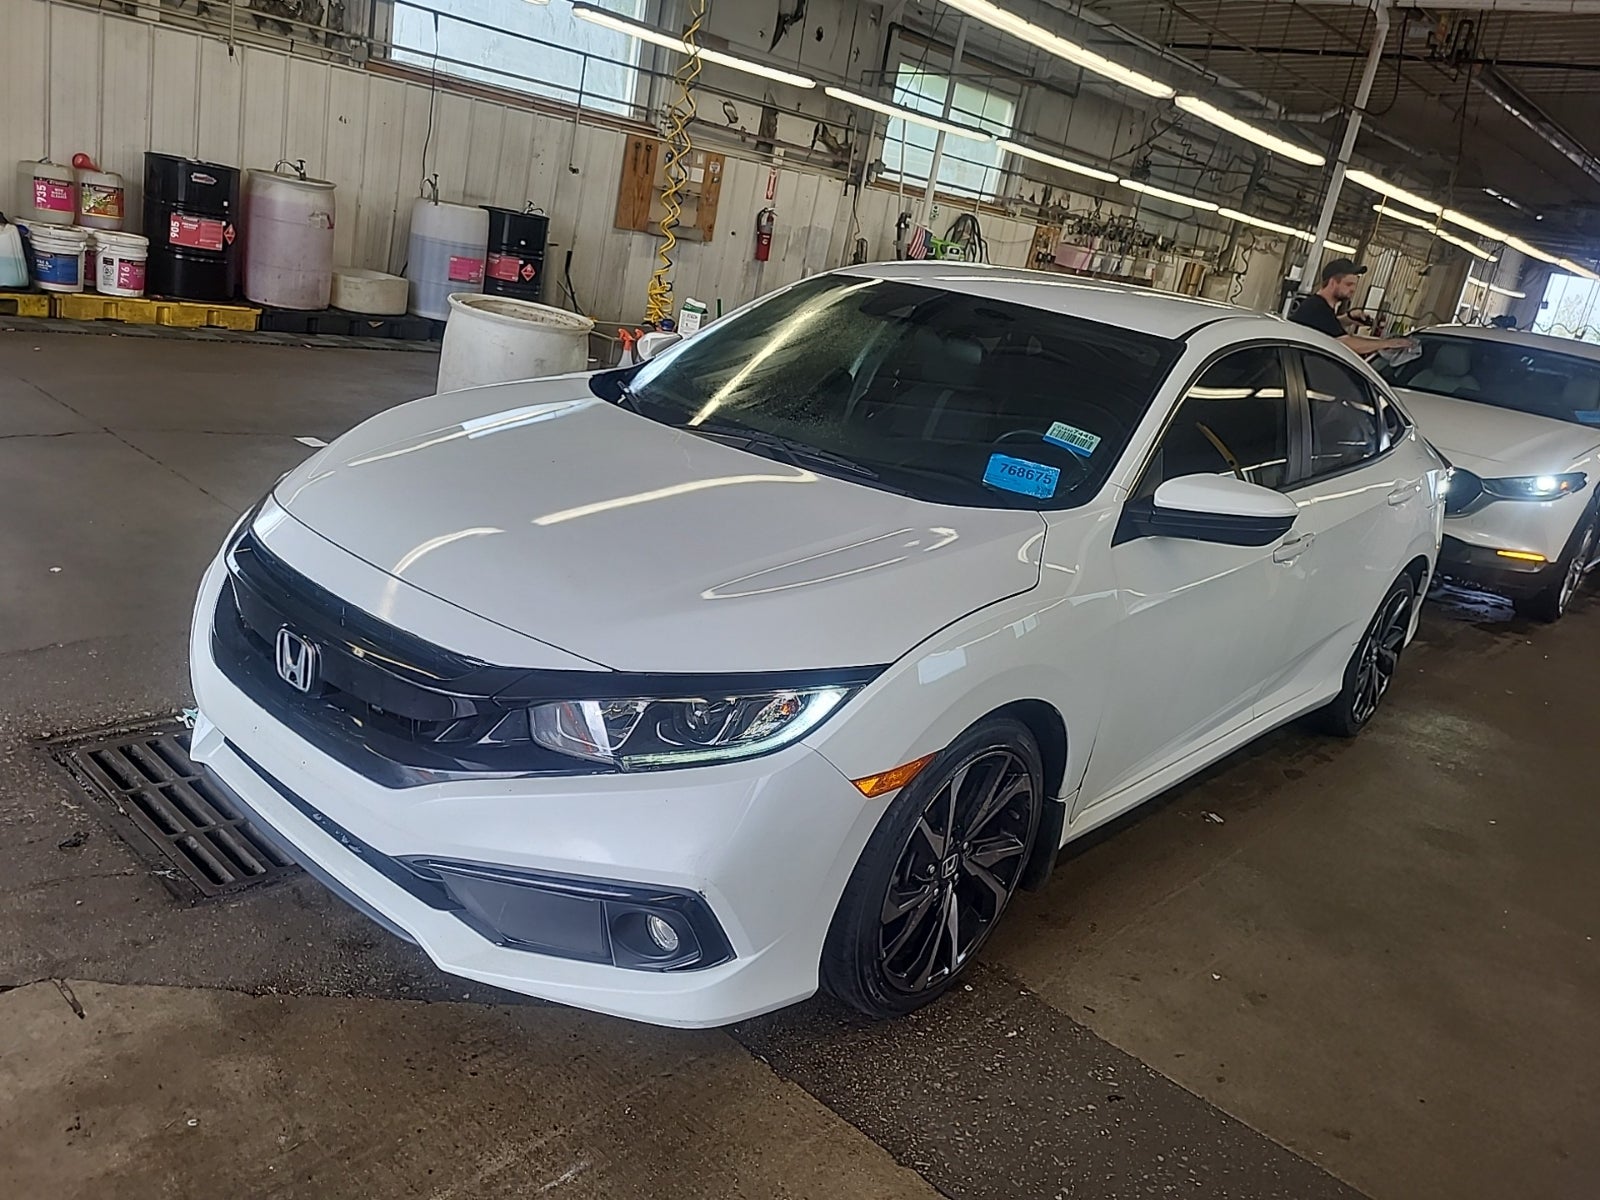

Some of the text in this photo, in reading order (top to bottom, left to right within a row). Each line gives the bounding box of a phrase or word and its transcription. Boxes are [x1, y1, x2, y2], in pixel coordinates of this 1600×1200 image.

[36, 184, 47, 202] 735
[170, 221, 180, 238] 905
[120, 266, 130, 284] 716
[1000, 463, 1053, 485] 768675
